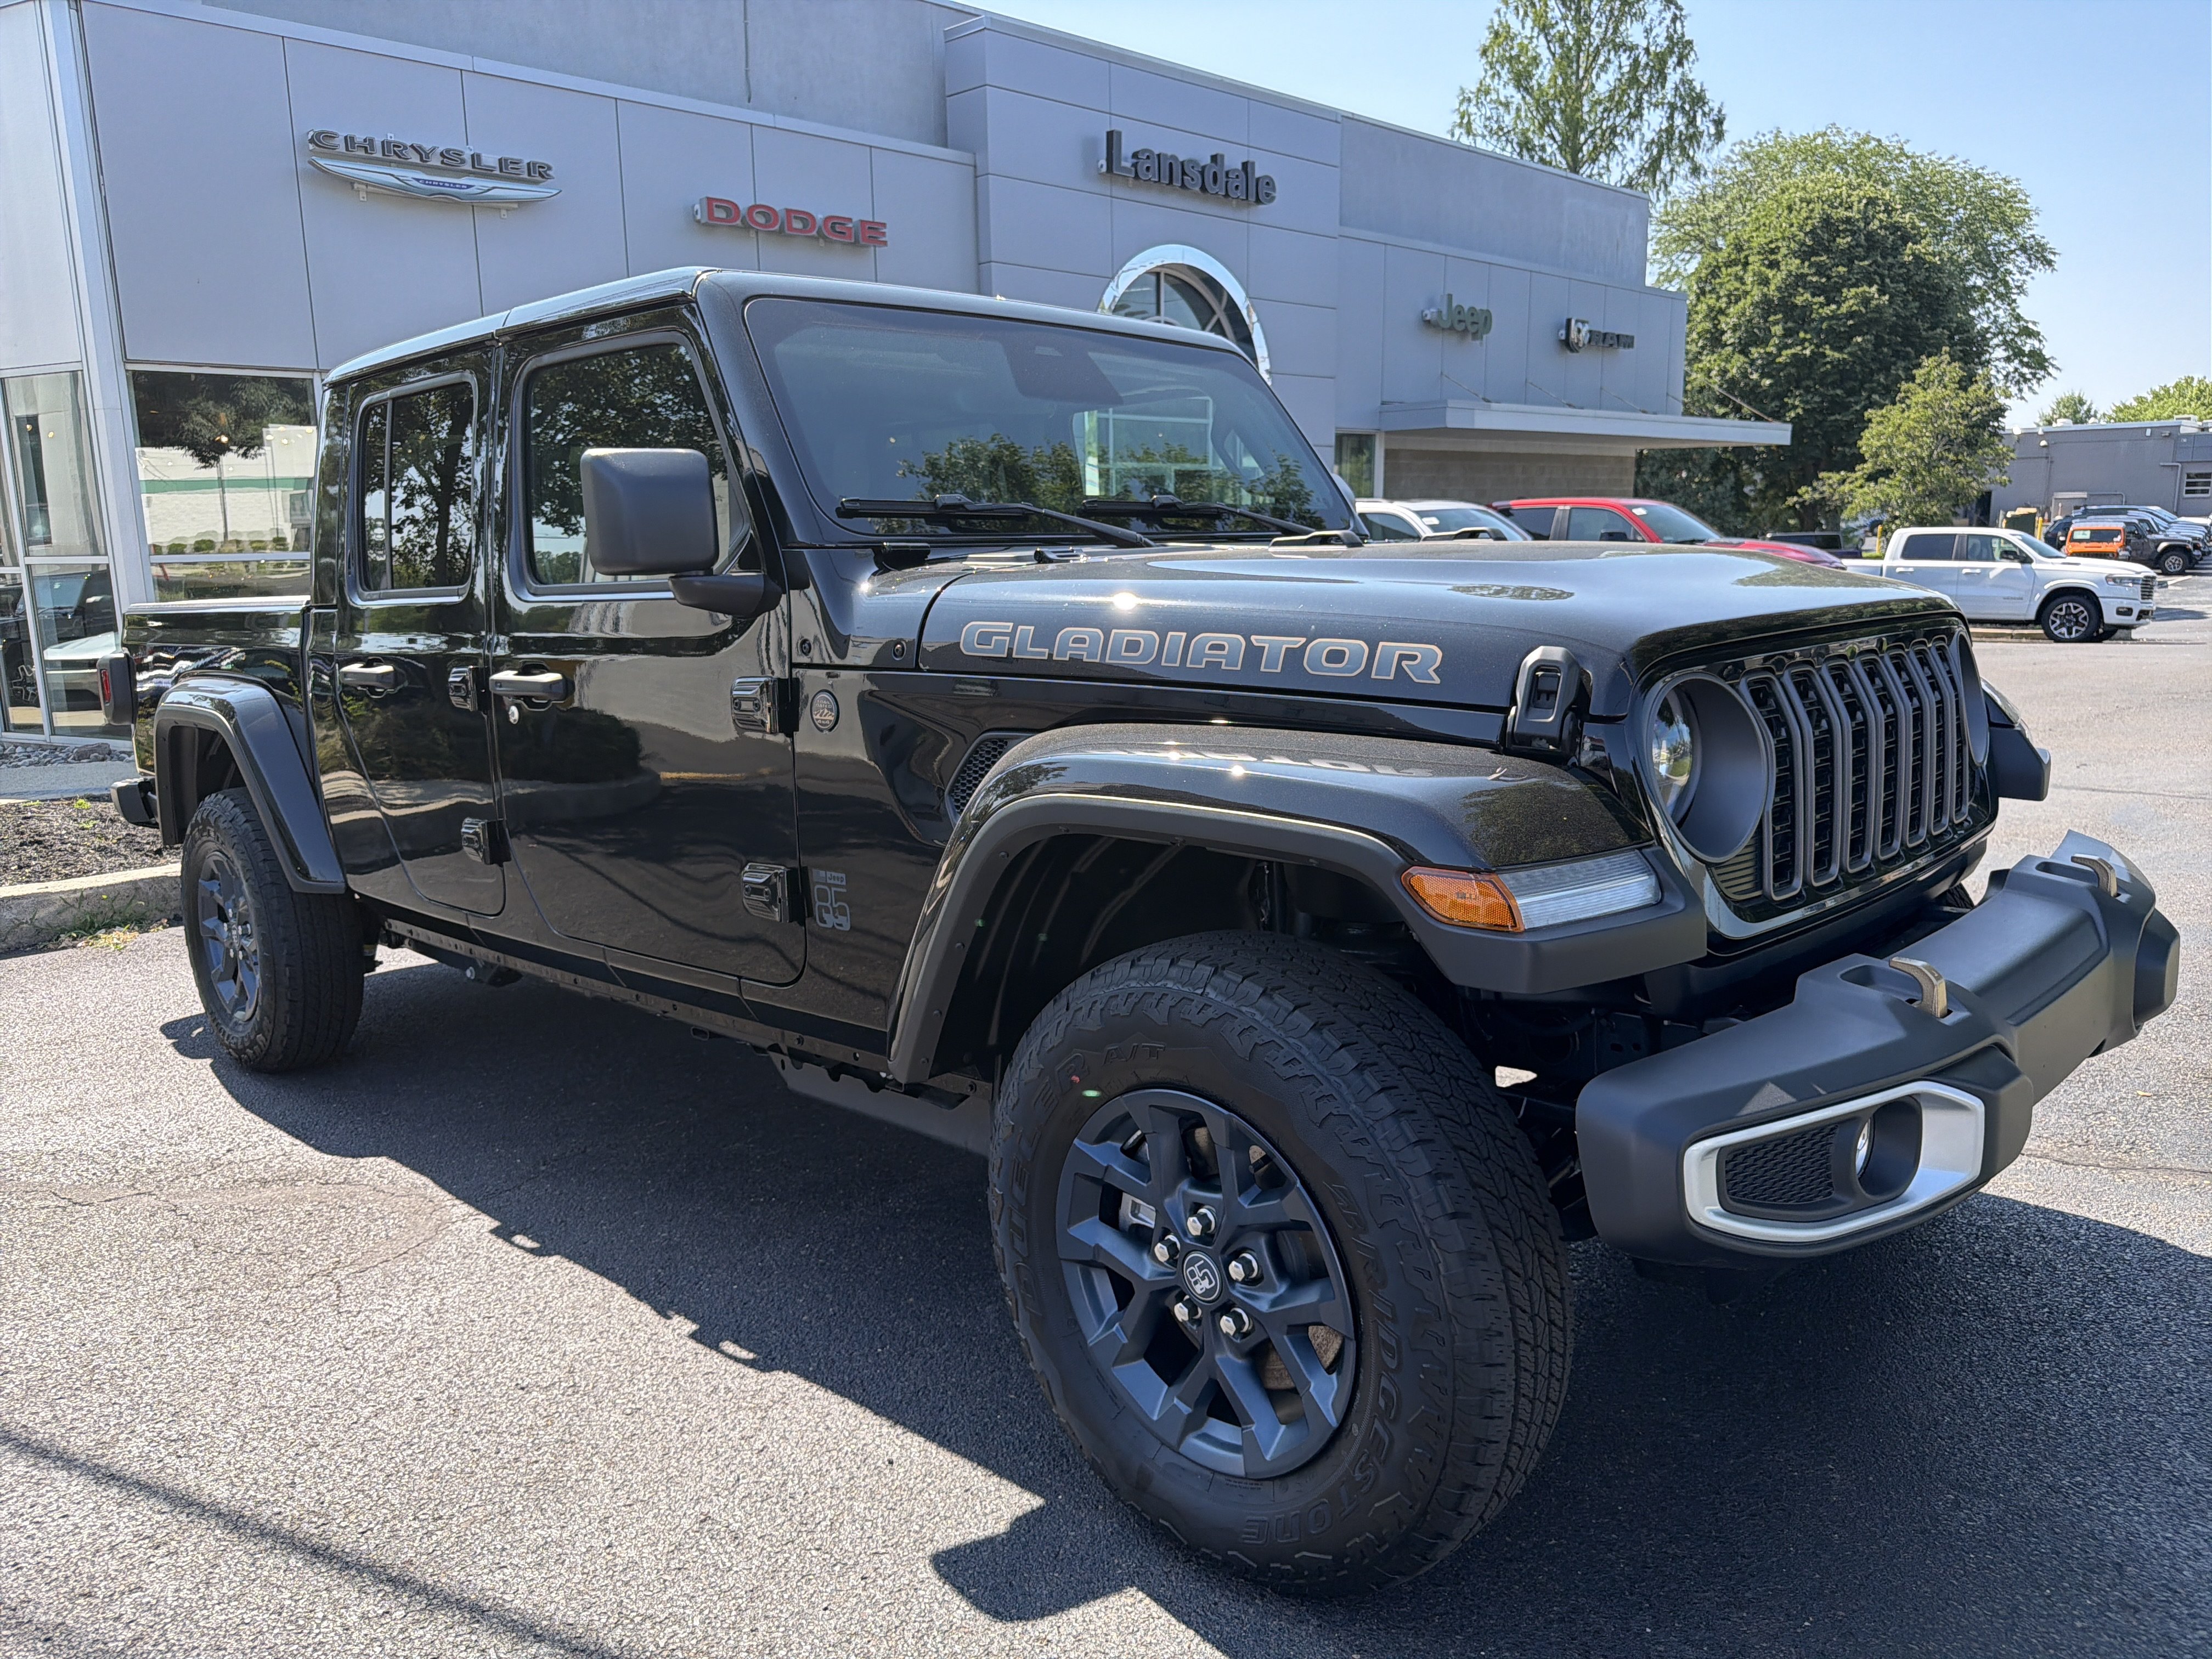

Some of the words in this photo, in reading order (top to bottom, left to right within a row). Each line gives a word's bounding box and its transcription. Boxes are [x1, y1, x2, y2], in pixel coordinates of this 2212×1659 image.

[309, 129, 555, 179] CHRYSLER
[1106, 129, 1277, 205] Lansdale
[701, 196, 888, 247] DODGE
[1437, 294, 1492, 341] Jeep
[1589, 330, 1634, 349] RAM
[960, 621, 1442, 684] GLADIATOR
[828, 873, 844, 883] Jeep
[1102, 1042, 1166, 1066] A/T
[1242, 1180, 1402, 1545] BRIDGESTONE
